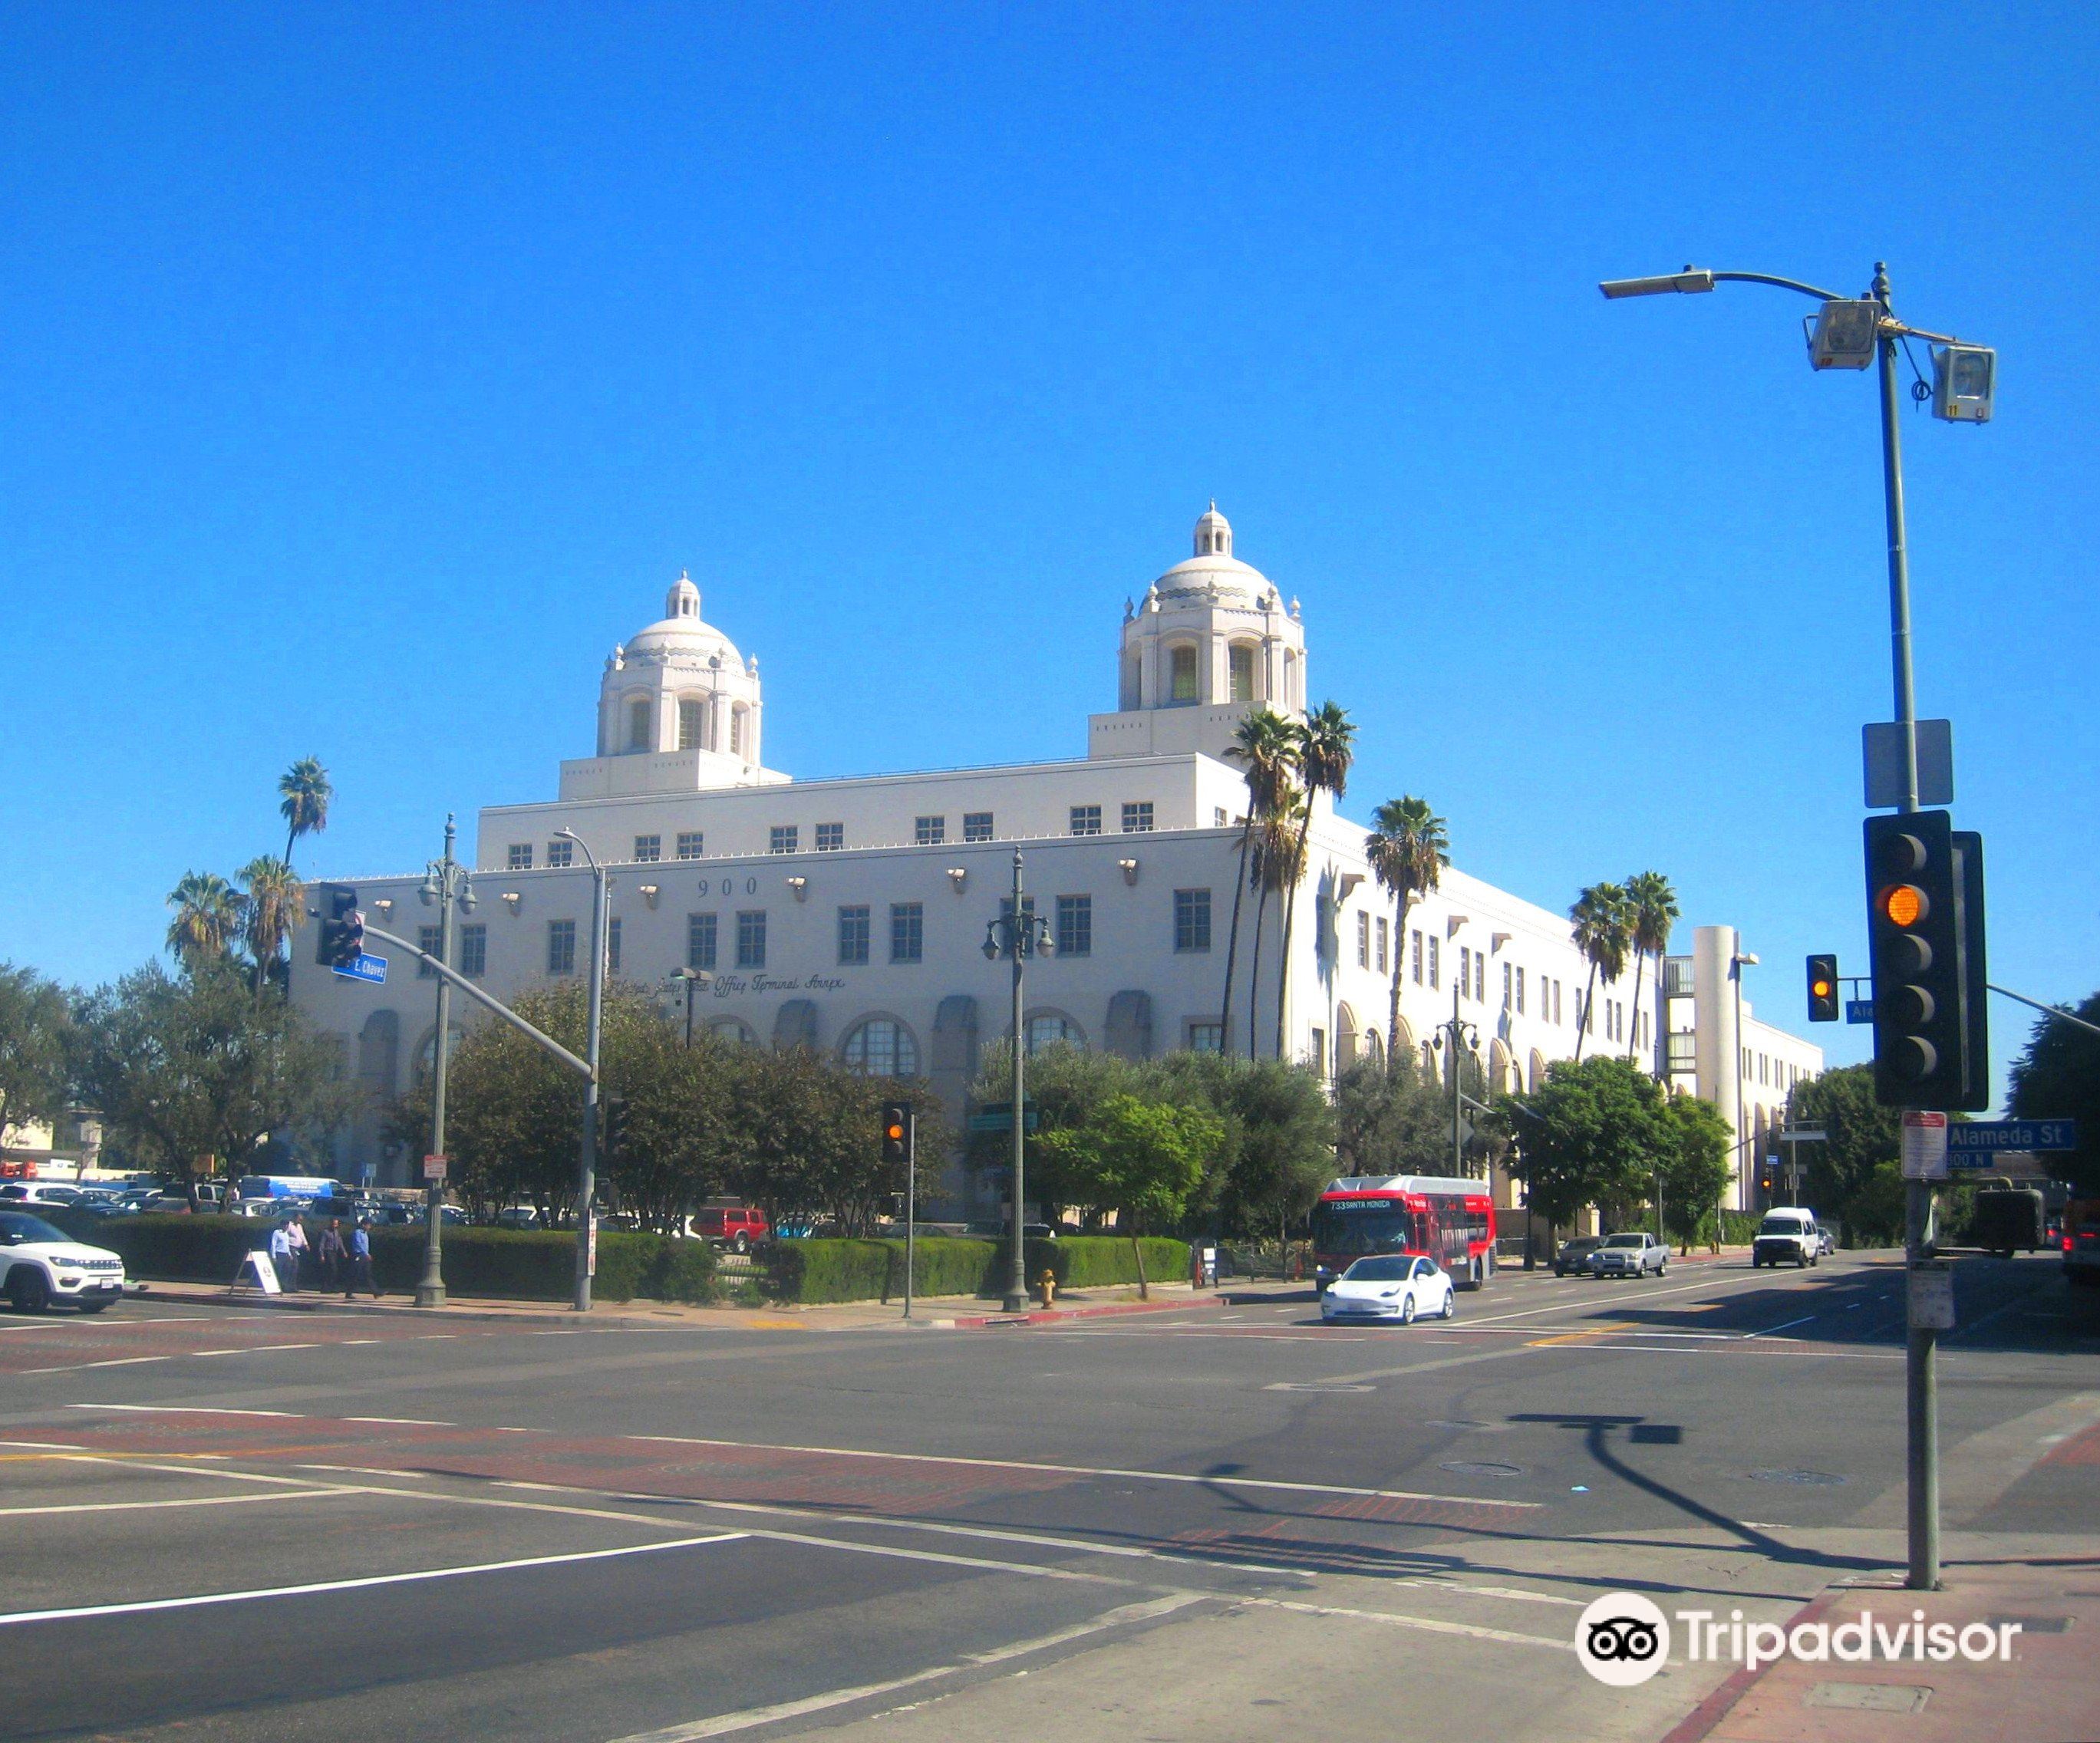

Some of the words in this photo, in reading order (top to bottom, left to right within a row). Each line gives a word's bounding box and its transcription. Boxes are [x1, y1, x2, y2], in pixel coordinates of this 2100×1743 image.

[362, 960, 385, 978] Chavez
[714, 976, 747, 997] Office
[751, 974, 799, 993] Terminal
[805, 974, 846, 992] Annex
[1951, 1127, 2033, 1145] Alameda
[2041, 1125, 2062, 1143] St
[1330, 1201, 1345, 1210] 733
[1346, 1201, 1366, 1209] SANTA
[1366, 1200, 1390, 1209] MONICA
